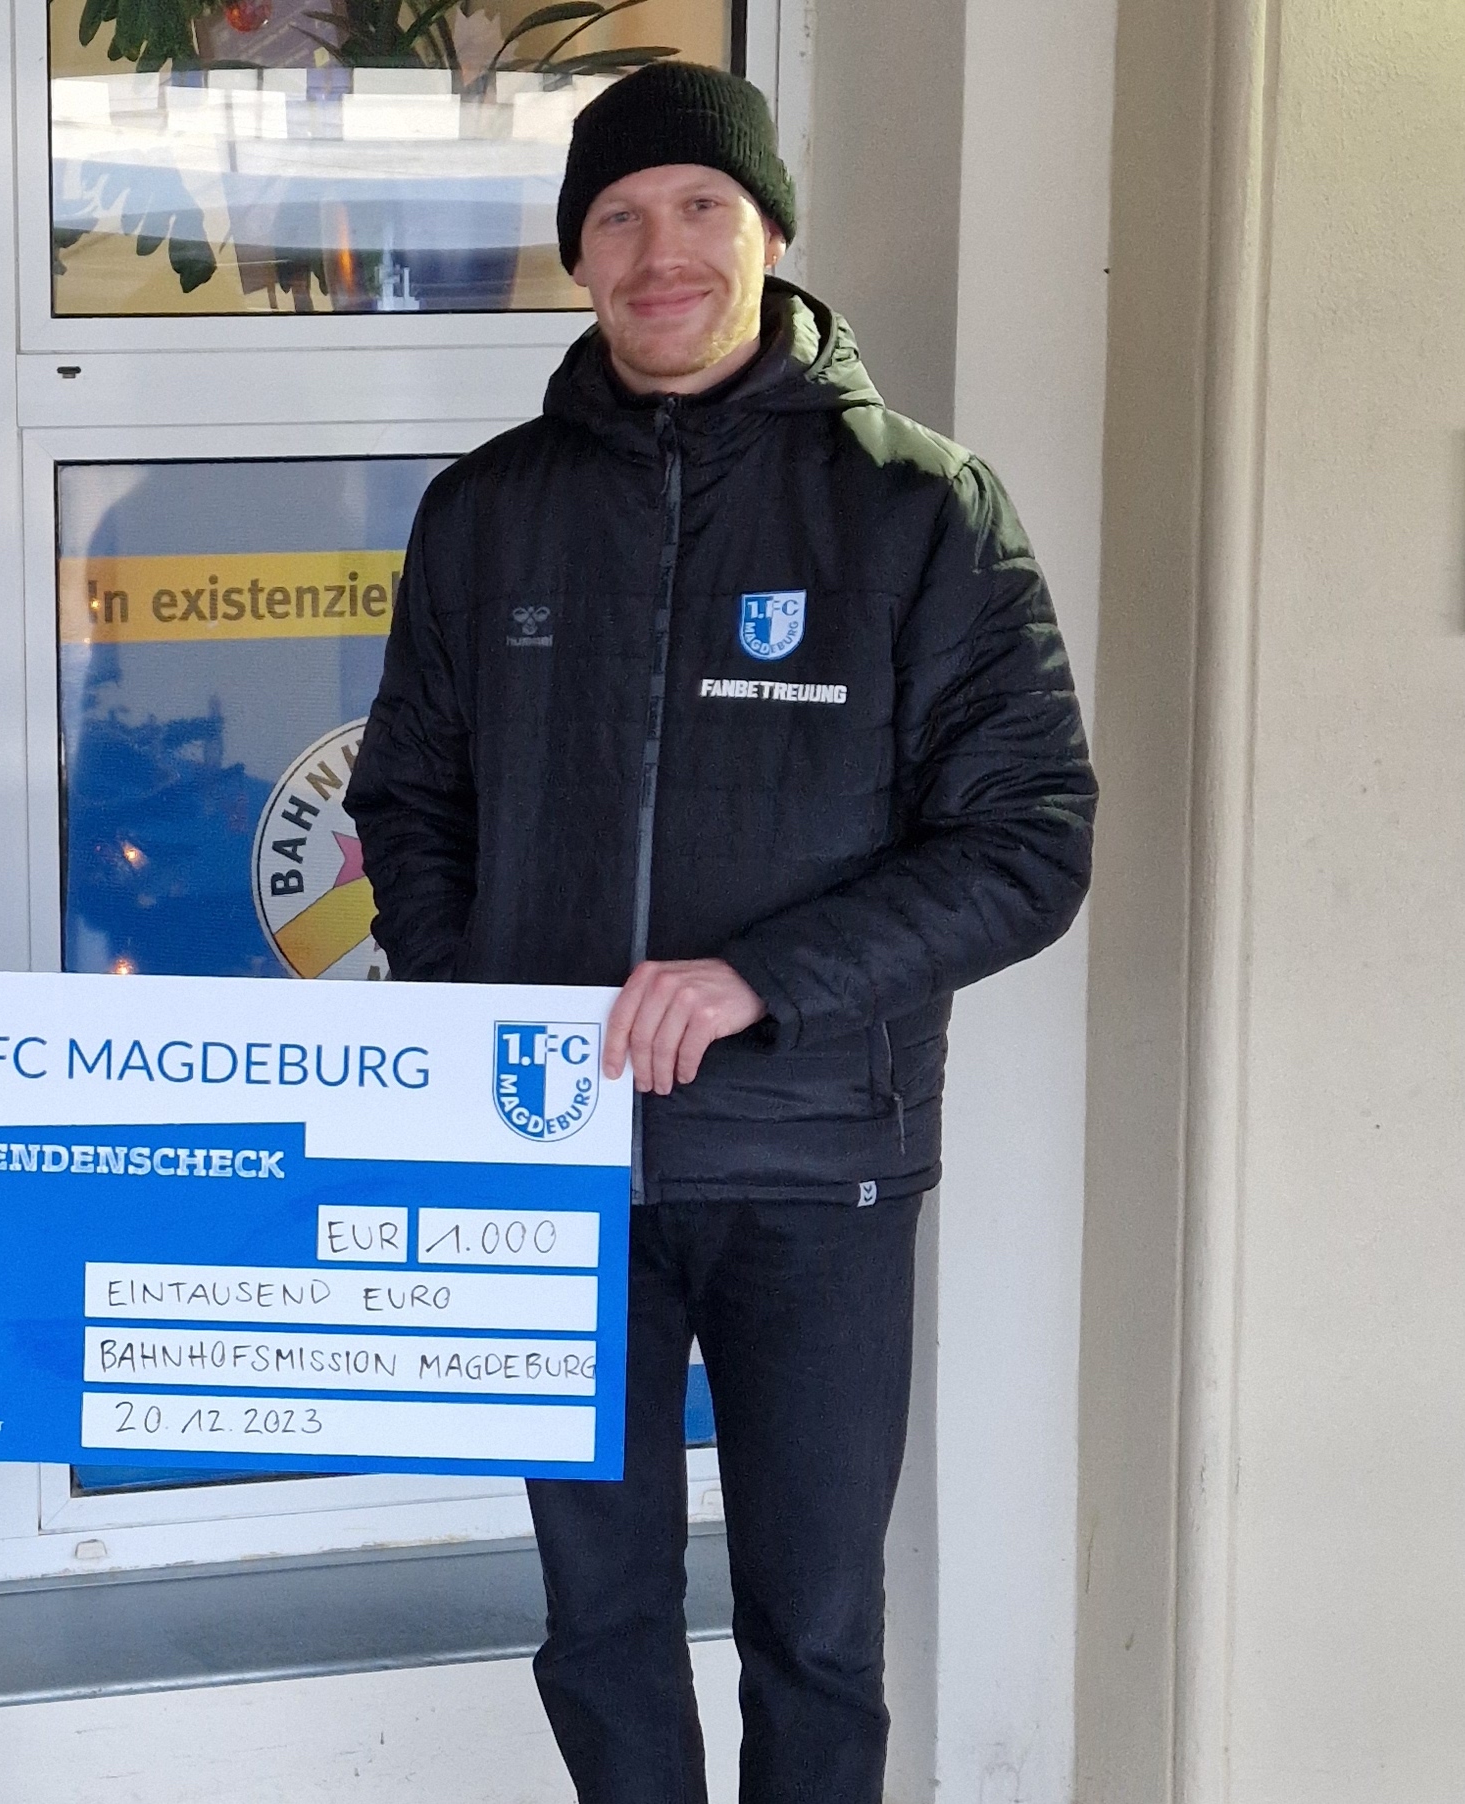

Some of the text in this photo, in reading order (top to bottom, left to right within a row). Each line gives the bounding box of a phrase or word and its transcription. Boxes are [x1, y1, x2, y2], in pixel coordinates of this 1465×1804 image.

[88, 579, 129, 624] In
[744, 621, 799, 655] MAGDEBURG
[700, 678, 848, 704] FANBETREUUNG
[68, 1039, 430, 1089] MAGDEBURG
[502, 1032, 591, 1066] 1.FC
[498, 1073, 592, 1135] MAGDEBURG
[328, 1219, 557, 1254] EUR 1.000
[108, 1279, 452, 1312] EINTAUSEND EURO
[100, 1338, 597, 1381] BAHNHOFSMISSION MAGDEBURG
